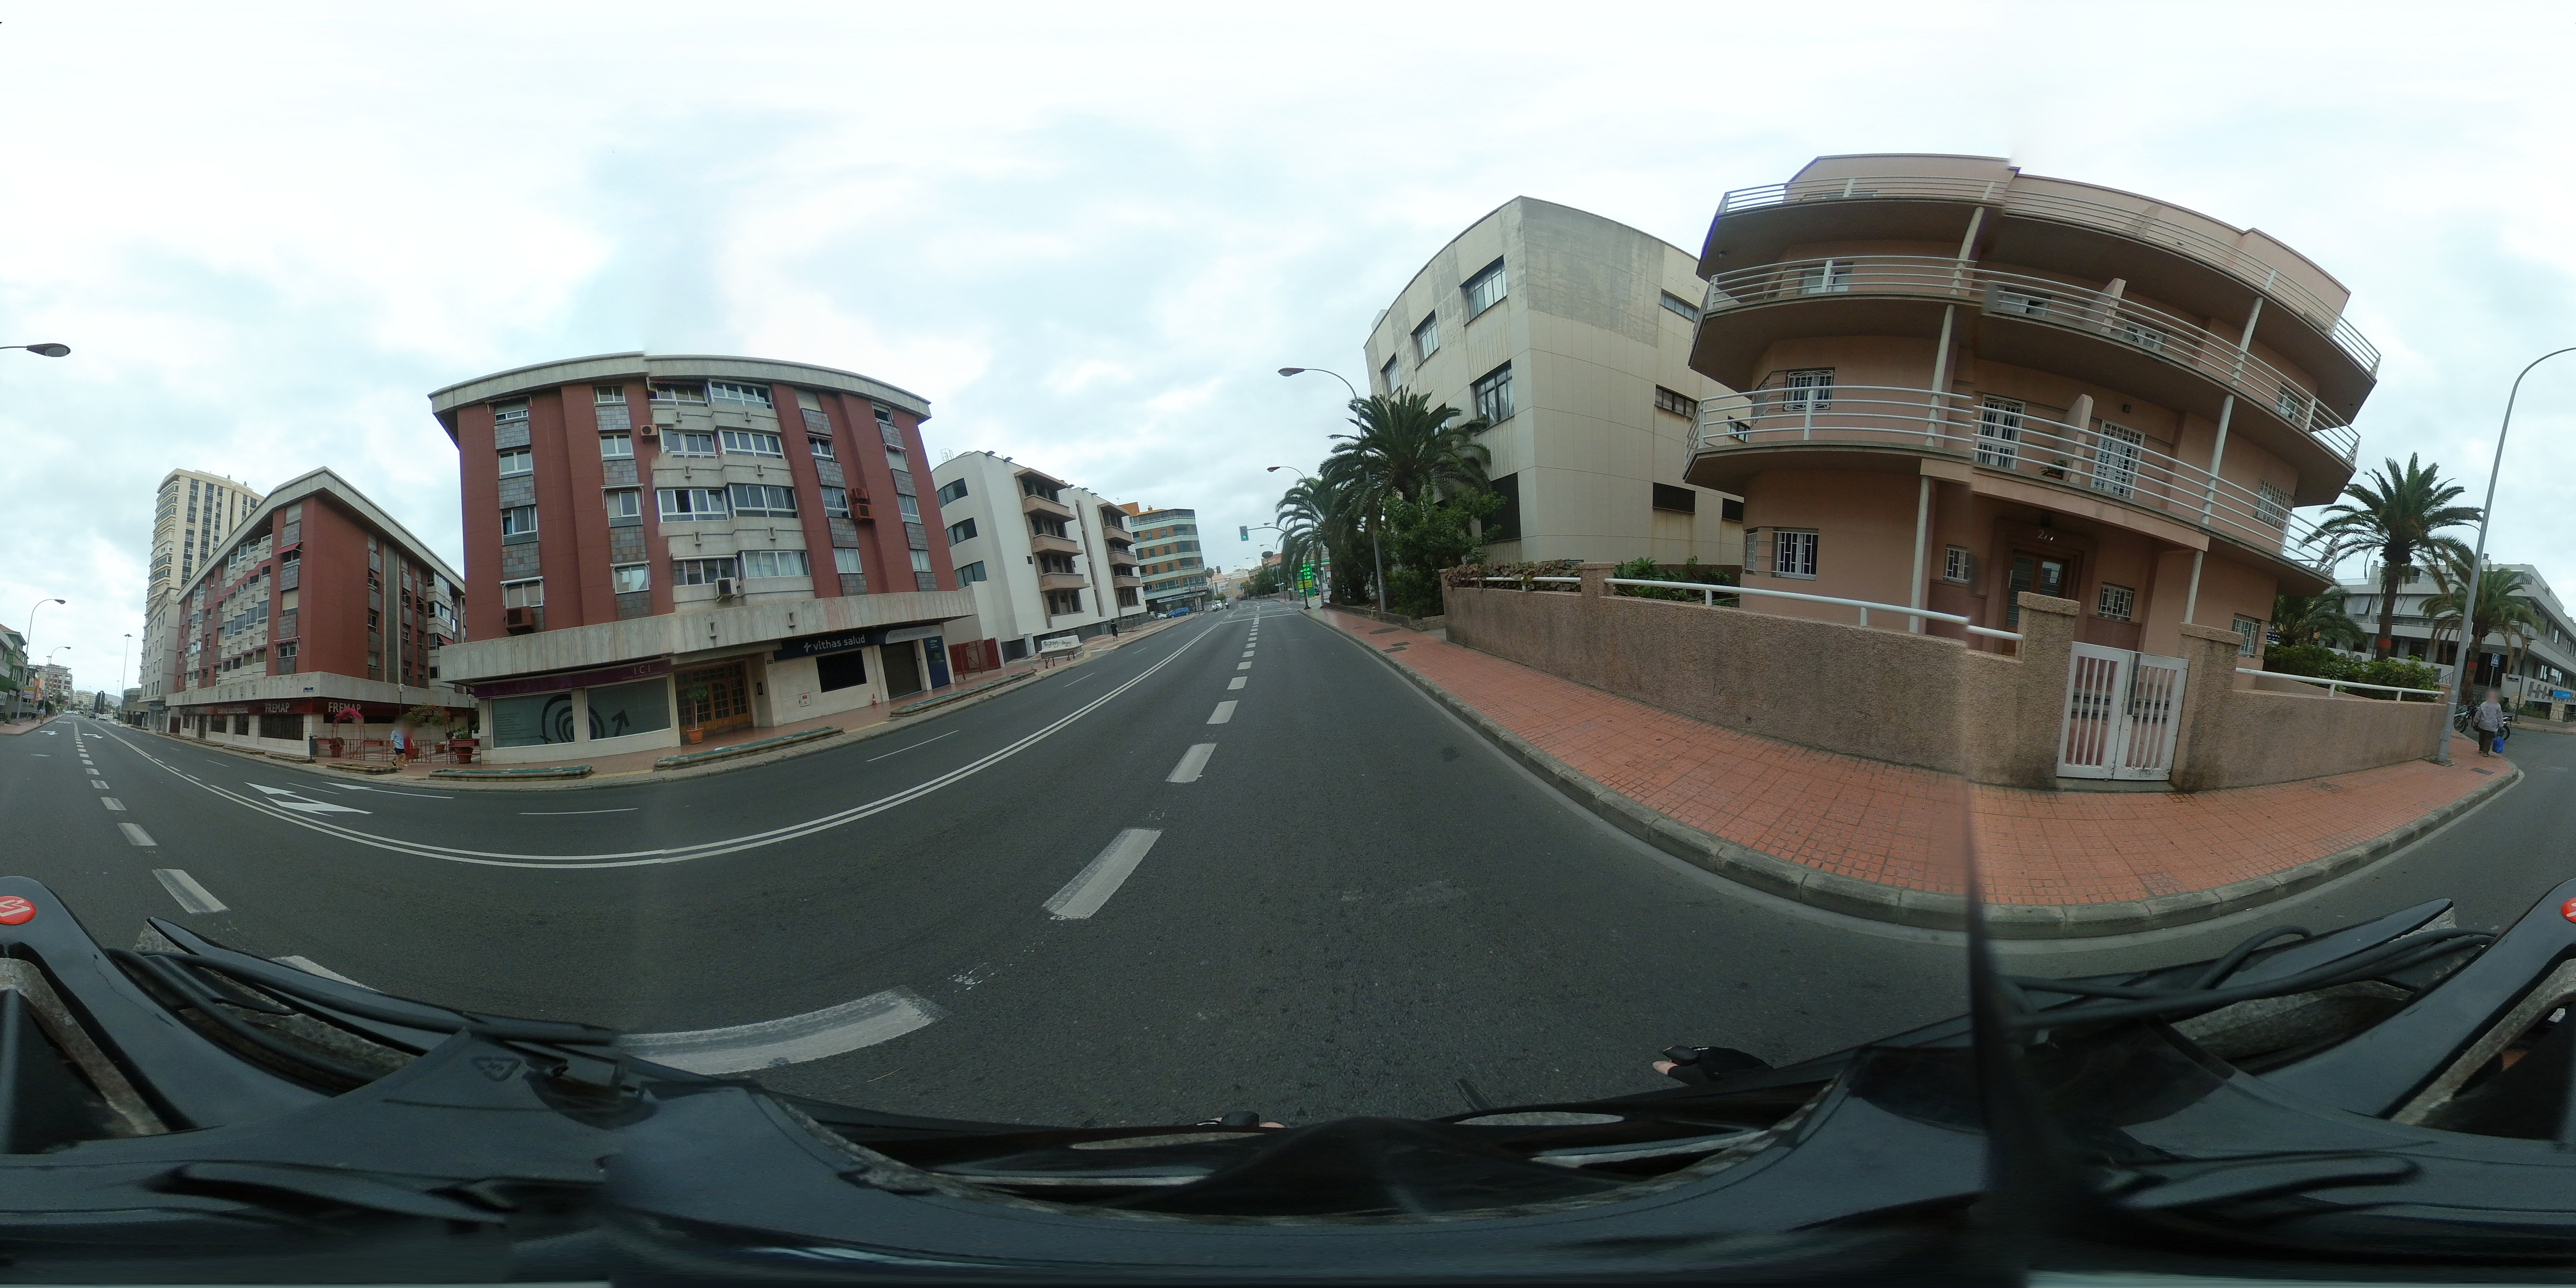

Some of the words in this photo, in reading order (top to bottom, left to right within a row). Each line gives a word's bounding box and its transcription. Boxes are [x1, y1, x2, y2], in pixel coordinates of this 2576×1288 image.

[812, 640, 841, 650] vithas
[844, 634, 865, 645] salud
[634, 665, 650, 674] ICI
[265, 702, 290, 713] FREMAP
[328, 702, 361, 713] FREMAP
